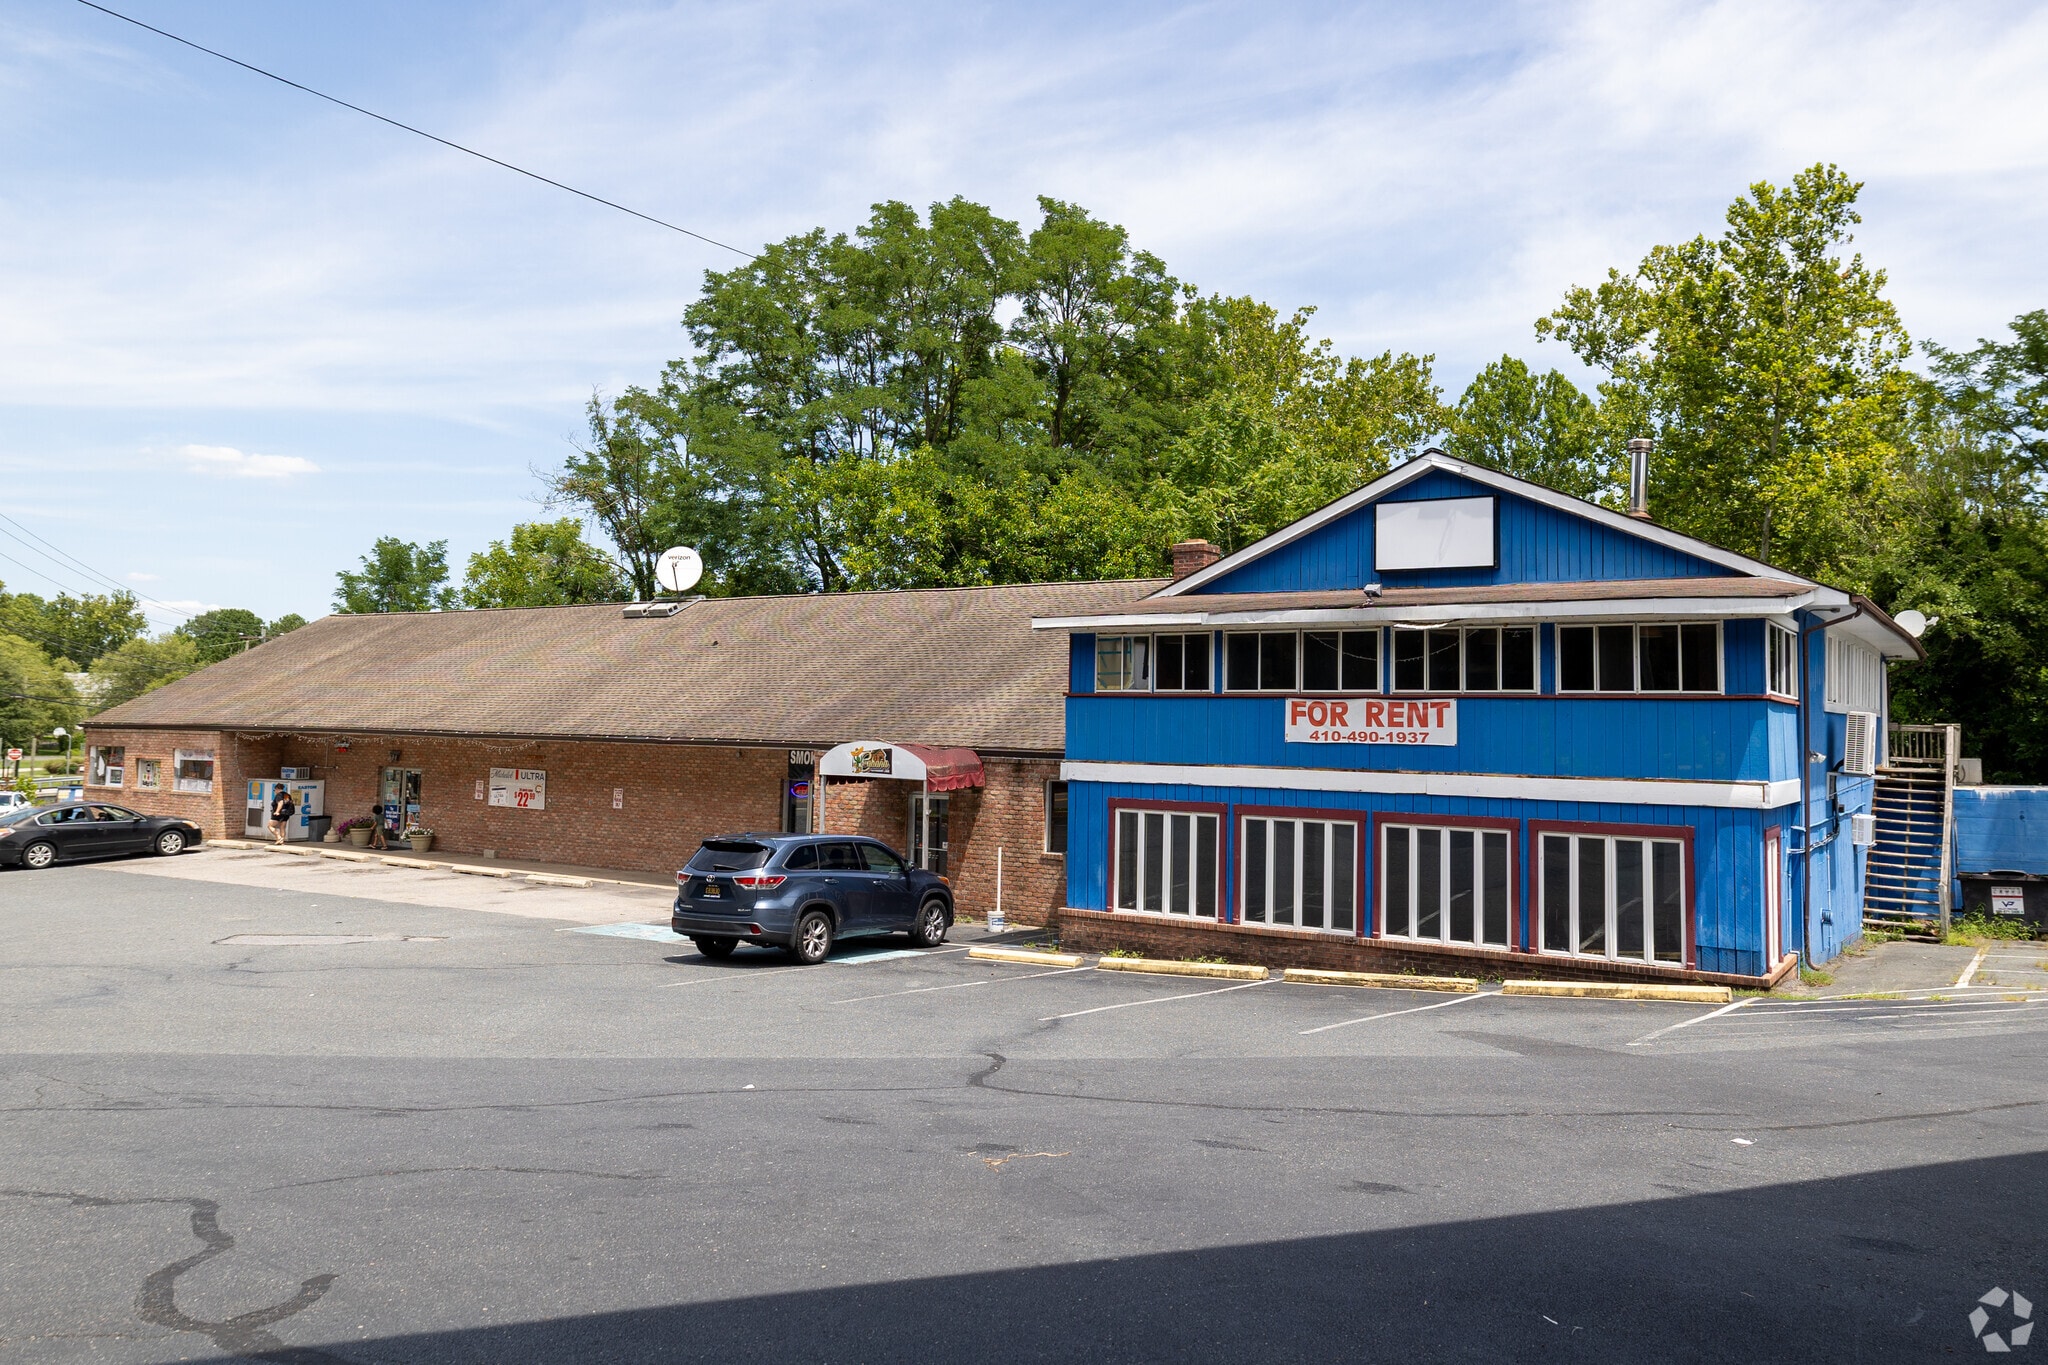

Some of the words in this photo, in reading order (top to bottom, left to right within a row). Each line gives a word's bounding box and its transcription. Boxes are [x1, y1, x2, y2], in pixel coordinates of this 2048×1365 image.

[1291, 701, 1348, 727] FOR
[1365, 701, 1451, 728] RENT
[1309, 730, 1430, 743] 410-490-1937
[521, 772, 544, 780] ULTRA
